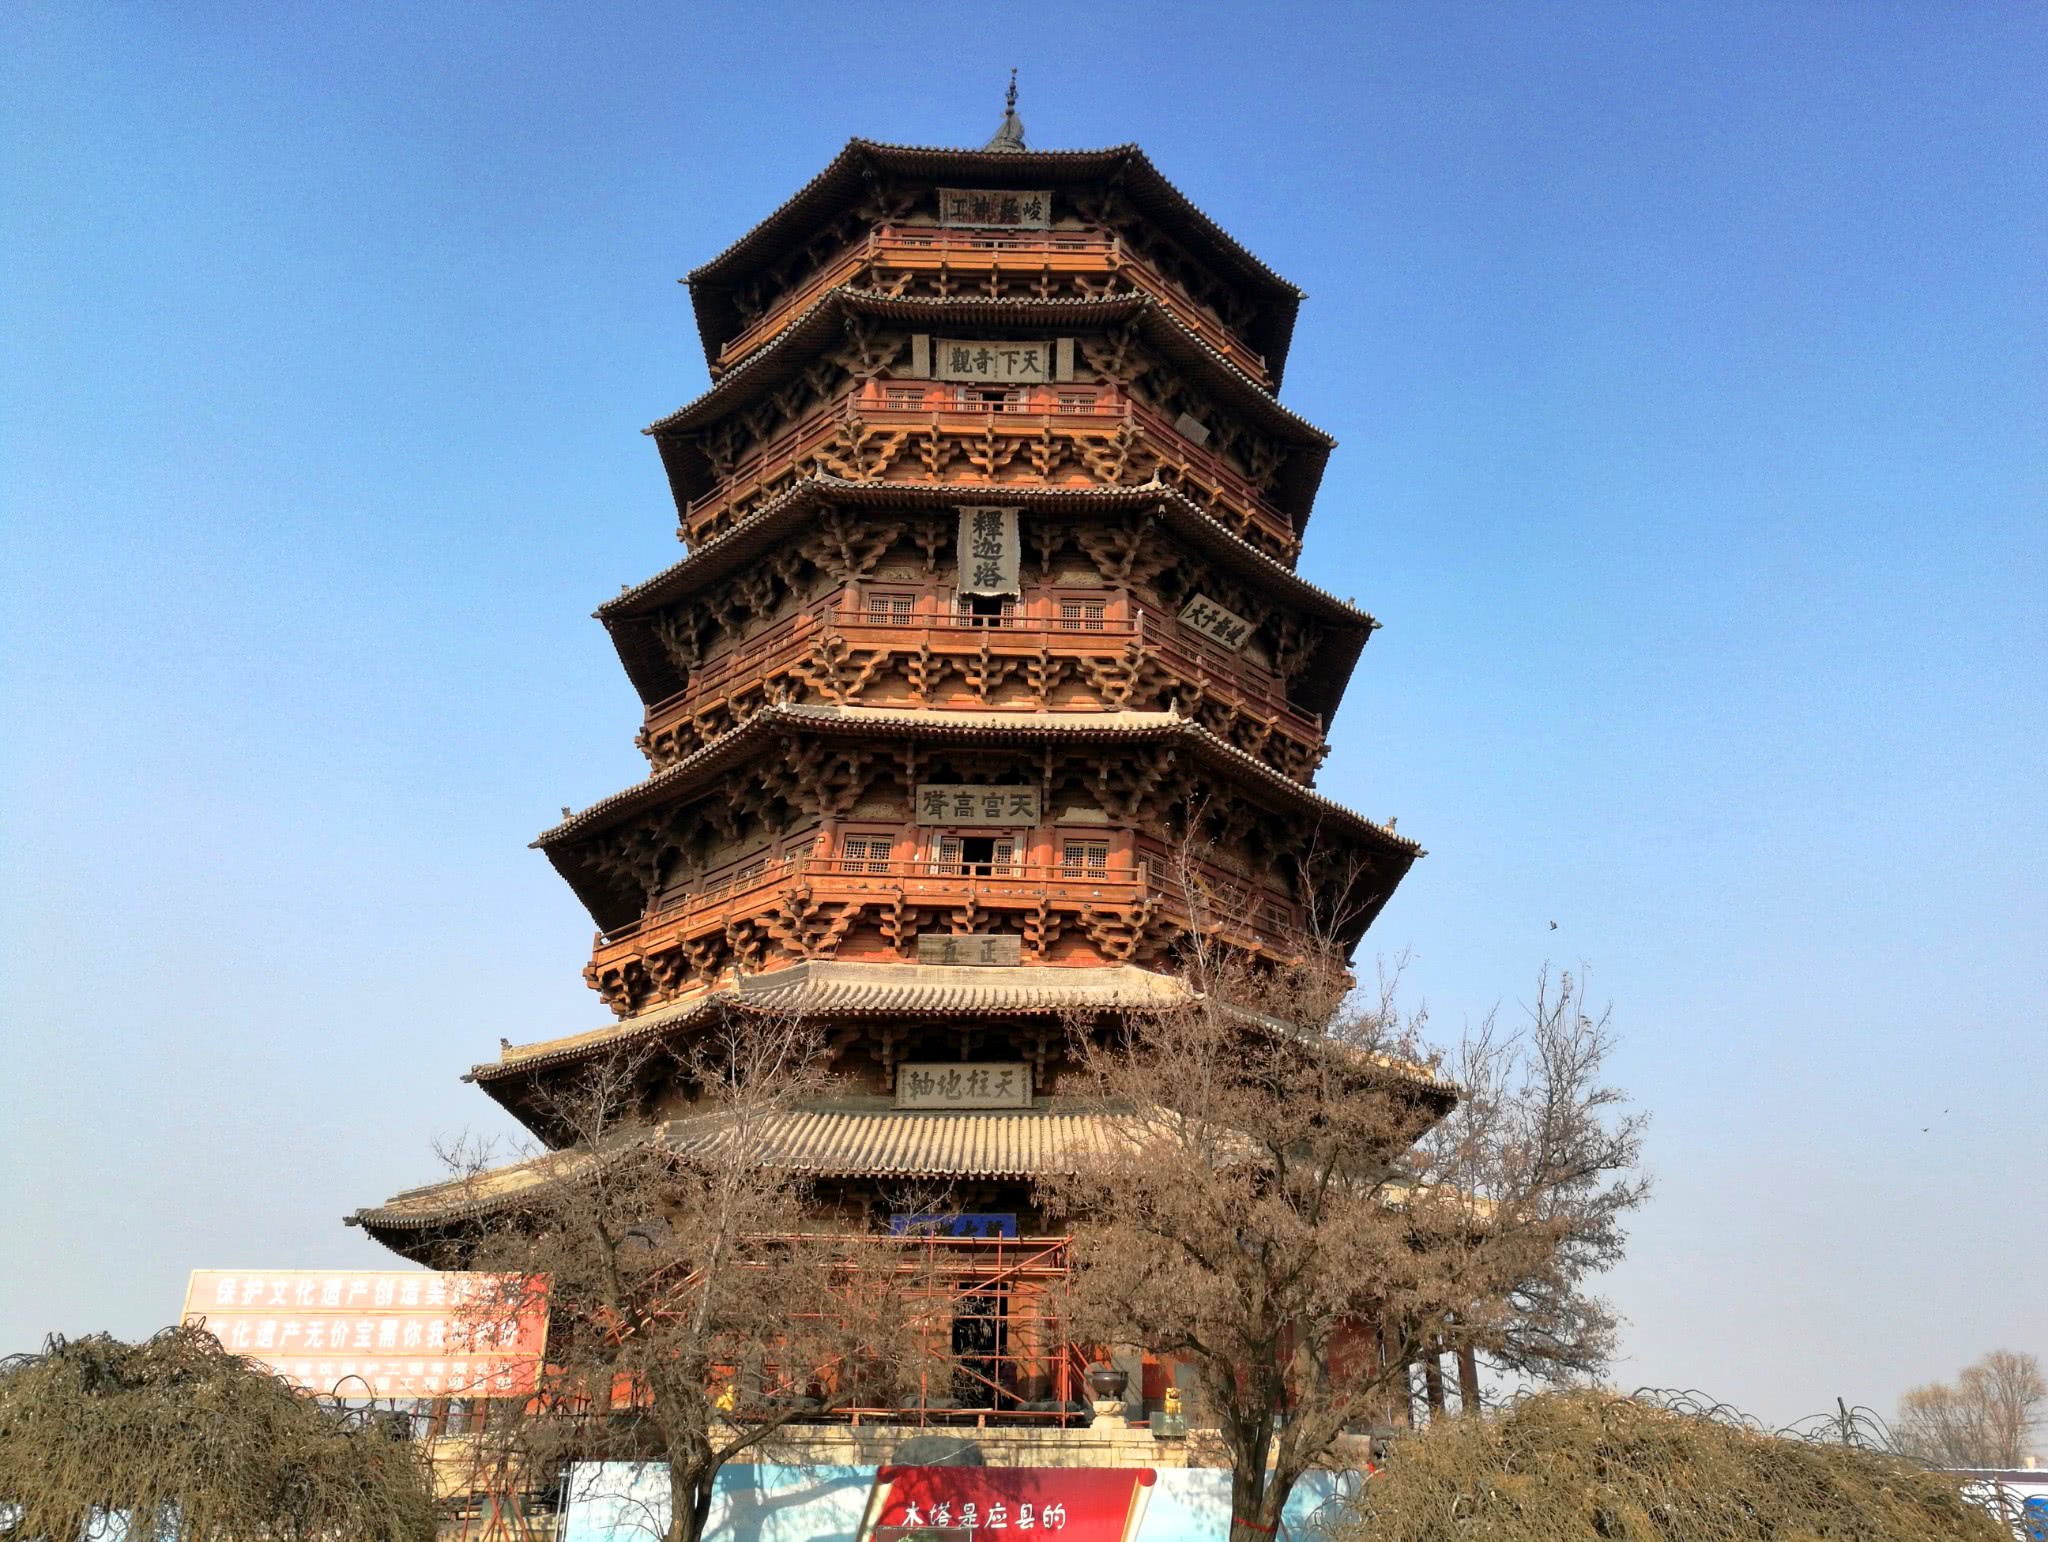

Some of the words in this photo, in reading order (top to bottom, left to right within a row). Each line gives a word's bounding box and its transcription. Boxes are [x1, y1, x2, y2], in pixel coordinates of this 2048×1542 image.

[972, 510, 1007, 588] 釋迦塔
[901, 1501, 1067, 1530] 木塔是应县的
